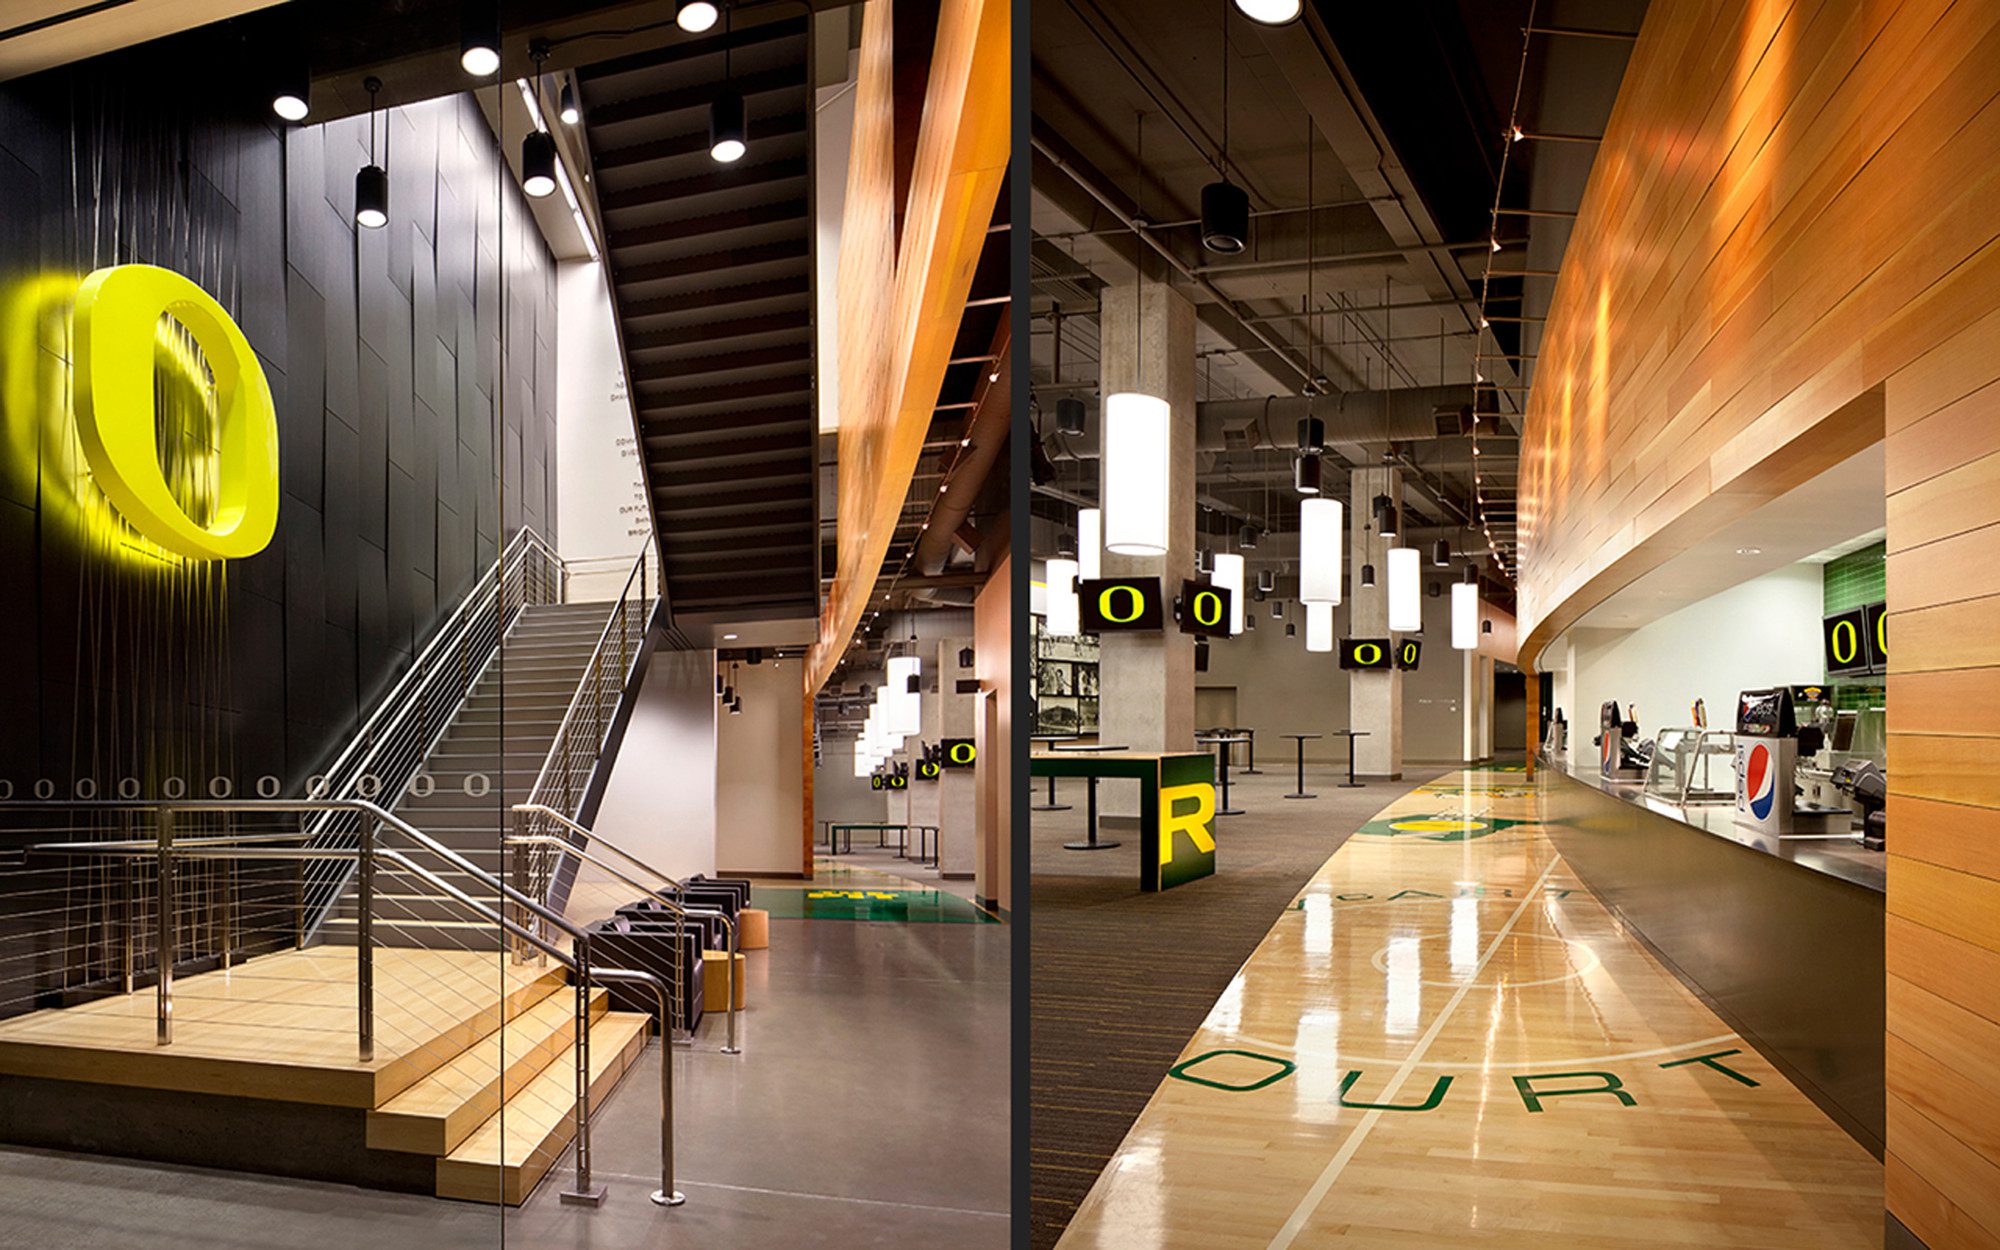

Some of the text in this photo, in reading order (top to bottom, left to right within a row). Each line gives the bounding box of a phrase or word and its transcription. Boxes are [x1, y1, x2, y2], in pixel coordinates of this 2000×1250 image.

[73, 264, 279, 559] O
[1099, 585, 1145, 622] O
[1194, 591, 1222, 626] O
[1354, 643, 1381, 665] O
[950, 743, 976, 763] O
[1160, 782, 1216, 865] R
